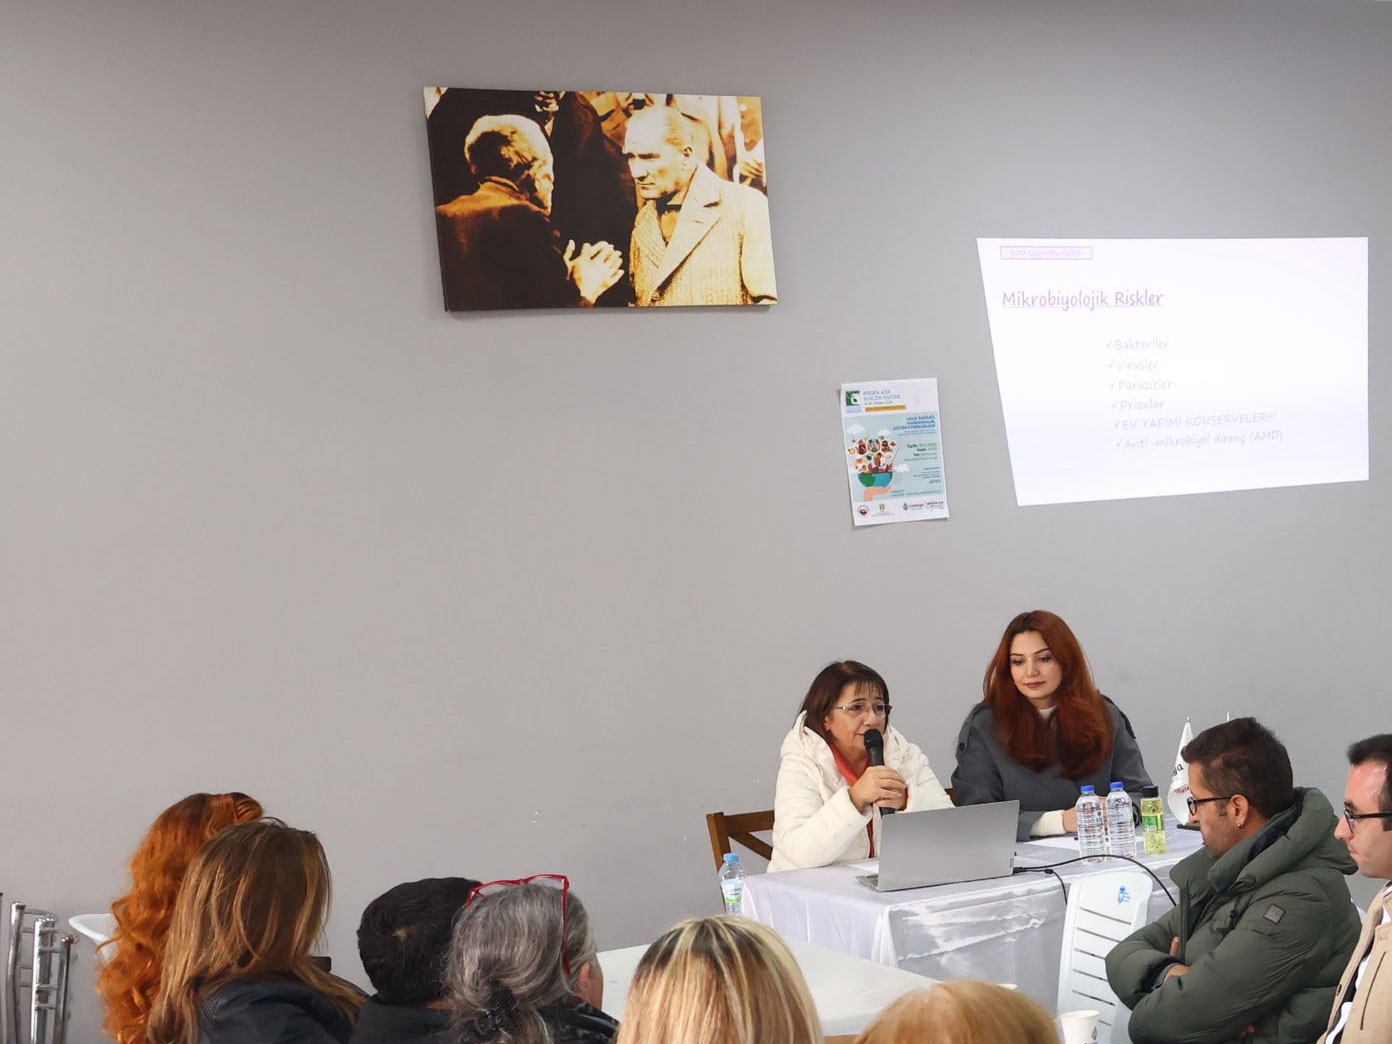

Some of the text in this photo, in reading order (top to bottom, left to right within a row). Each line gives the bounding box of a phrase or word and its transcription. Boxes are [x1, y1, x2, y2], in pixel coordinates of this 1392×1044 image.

[1002, 289, 1163, 311] Mikrobiyolojik Riskler
[1114, 336, 1170, 350] Bakteriler
[1122, 419, 1138, 430] EV
